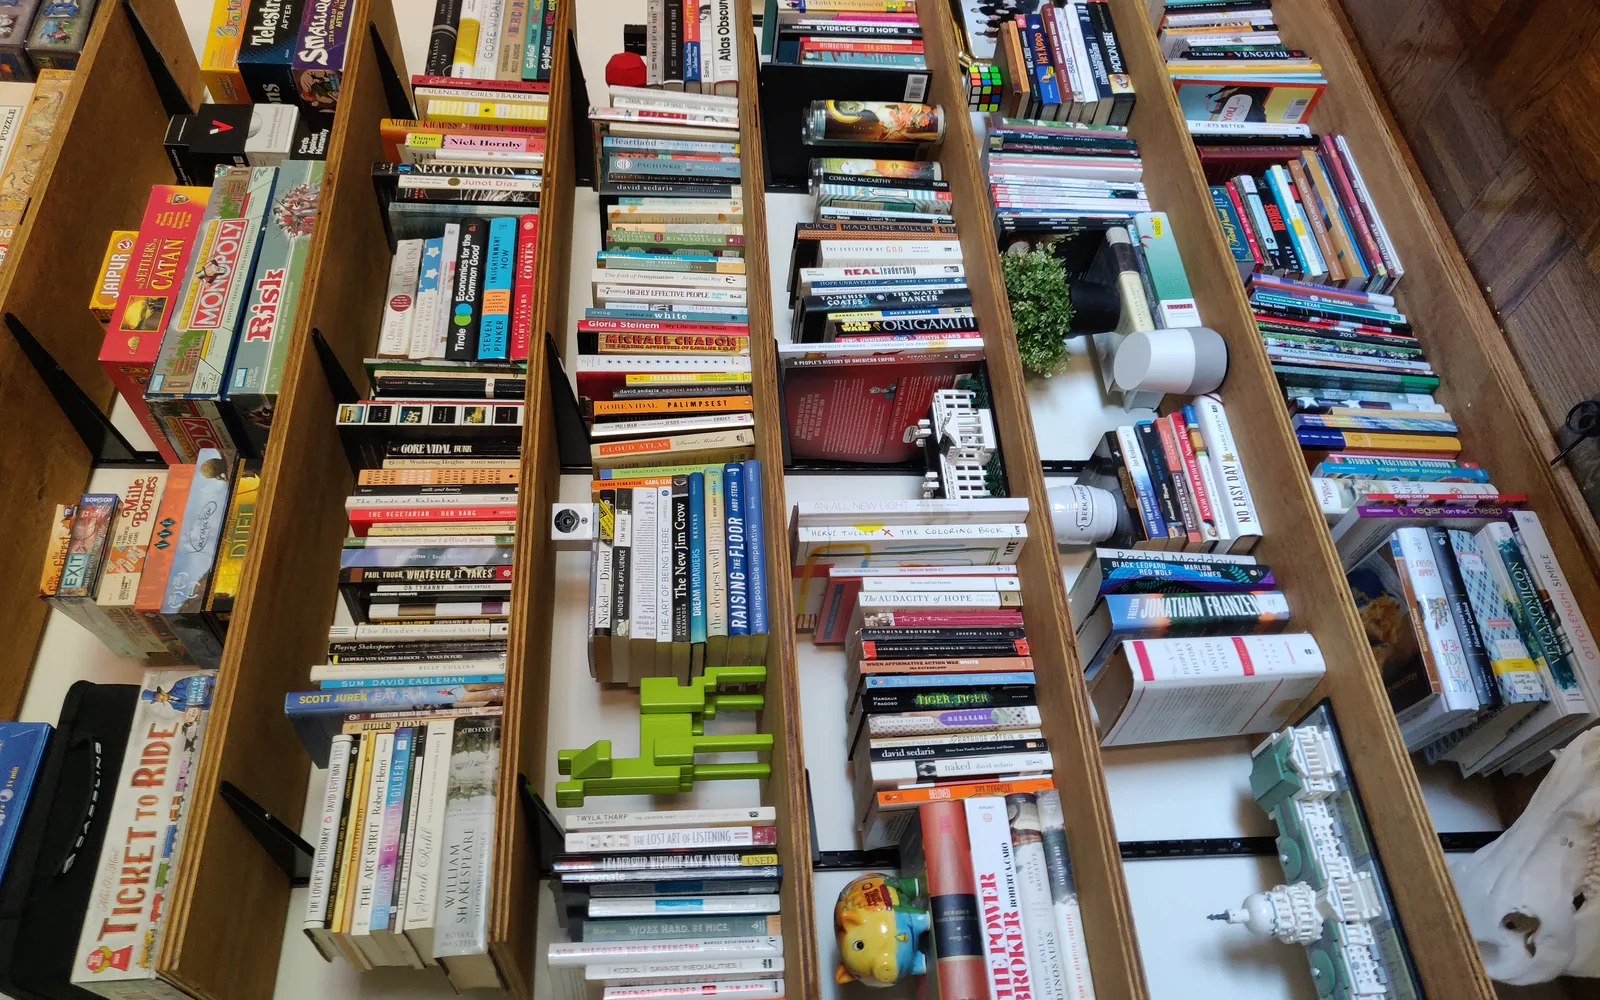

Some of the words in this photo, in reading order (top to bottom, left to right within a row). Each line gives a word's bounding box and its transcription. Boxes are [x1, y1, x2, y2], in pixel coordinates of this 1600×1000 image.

[281, 4, 292, 29] AFTER
[717, 0, 730, 35] Obscur
[484, 32, 496, 59] GORE
[490, 1, 500, 30] VIDAL
[718, 37, 731, 61] Atlas
[427, 89, 460, 97] SILENCE
[470, 91, 493, 99] GIRLS
[1, 109, 16, 141] PUZZLE
[299, 141, 309, 154] Cards
[316, 129, 329, 154] Humanity
[450, 138, 476, 146] Nick
[480, 138, 522, 149] Hornby
[611, 138, 656, 146] Heartland
[414, 164, 515, 175] NEGOTIATION
[843, 224, 895, 232] MADELINE
[135, 243, 156, 283] SETTLERS
[151, 238, 185, 290] CATAN
[490, 236, 500, 284] ENLIGHTENMENT
[523, 242, 534, 280] COATES
[844, 268, 879, 276] REAL
[881, 266, 916, 276] leadership
[101, 253, 130, 298] JAIPUR
[197, 222, 244, 326] MONOPOLY
[457, 260, 468, 302] Economics
[466, 266, 477, 302] Common
[627, 289, 650, 297] HIGHLY
[651, 290, 684, 298] EFFECTIVE
[902, 295, 938, 303] DANCER
[483, 320, 492, 352] STEVEN
[494, 320, 503, 351] PINKER
[883, 318, 963, 331] ORIGAMI
[455, 328, 466, 351] Tirole
[605, 334, 668, 343] MICHAEL
[673, 336, 736, 346] CHABON
[401, 444, 424, 454] GORE
[425, 444, 451, 454] VIDAL
[601, 445, 635, 453] CLOUD
[639, 442, 669, 450] ATLAS
[1225, 465, 1238, 482] DAY
[122, 479, 144, 518] Mille
[132, 476, 158, 528] Bornes
[1231, 483, 1246, 507] EASY
[675, 503, 688, 529] Crow
[1237, 509, 1251, 523] NO
[1411, 507, 1445, 515] vegan
[1467, 507, 1502, 515] cheap
[674, 531, 688, 551] Jim
[728, 517, 744, 557] FLOOR
[1003, 541, 1019, 556] TATE
[601, 550, 611, 580] Dimed
[675, 551, 687, 575] New
[692, 548, 701, 588] HOARDERS
[710, 549, 720, 569] well
[733, 558, 741, 570] THE
[1541, 554, 1562, 587] SIMPLE
[64, 556, 83, 587] EXIT
[365, 570, 380, 578] PAUL
[406, 570, 452, 580] WHATEVER
[466, 570, 493, 579] TAKES
[675, 575, 687, 599] The
[710, 571, 723, 608] deepest
[934, 595, 941, 603] of
[599, 595, 609, 625] Nickel
[618, 597, 626, 616] UNDER
[693, 589, 701, 616] DREAM
[730, 572, 747, 628] RAISING
[1127, 599, 1139, 619] FREEDOM
[1141, 596, 1203, 619] JONATHAN
[1204, 594, 1261, 616] FRANZEN
[1556, 589, 1595, 660] OTTOLENGHI
[334, 644, 356, 652] Playing
[358, 643, 395, 651] Shakespeare
[299, 695, 332, 704] SCOTT
[334, 693, 367, 702] JUREK
[375, 693, 395, 701] EAT
[403, 691, 427, 699] RUN
[917, 695, 953, 704] TIGER,
[957, 694, 988, 703] TIGER
[129, 723, 179, 788] RIDE
[881, 749, 904, 757] david
[906, 748, 935, 756] sedaris
[377, 759, 387, 783] Henri
[944, 762, 971, 771] naked
[135, 795, 158, 821] TO
[373, 786, 384, 816] Robert
[320, 827, 331, 868] DICTIONARY
[369, 823, 379, 856] SPIRIT
[647, 833, 664, 844] LOST
[665, 833, 680, 844] ART
[692, 830, 731, 842] LISTENING
[747, 856, 774, 865] USED
[1001, 842, 1010, 863] CARO
[365, 857, 373, 880] ART
[445, 844, 461, 908] WILLIAM
[456, 828, 474, 923] SHAKESPEARE
[579, 872, 625, 881] resonate
[97, 827, 157, 941] TICKET
[361, 885, 371, 909] THE
[980, 872, 1008, 956] POWER
[629, 925, 658, 935] WORK
[661, 924, 689, 933] HARD.
[682, 963, 736, 971] INEQUALITIES
[1003, 910, 1032, 1000] BROKER
